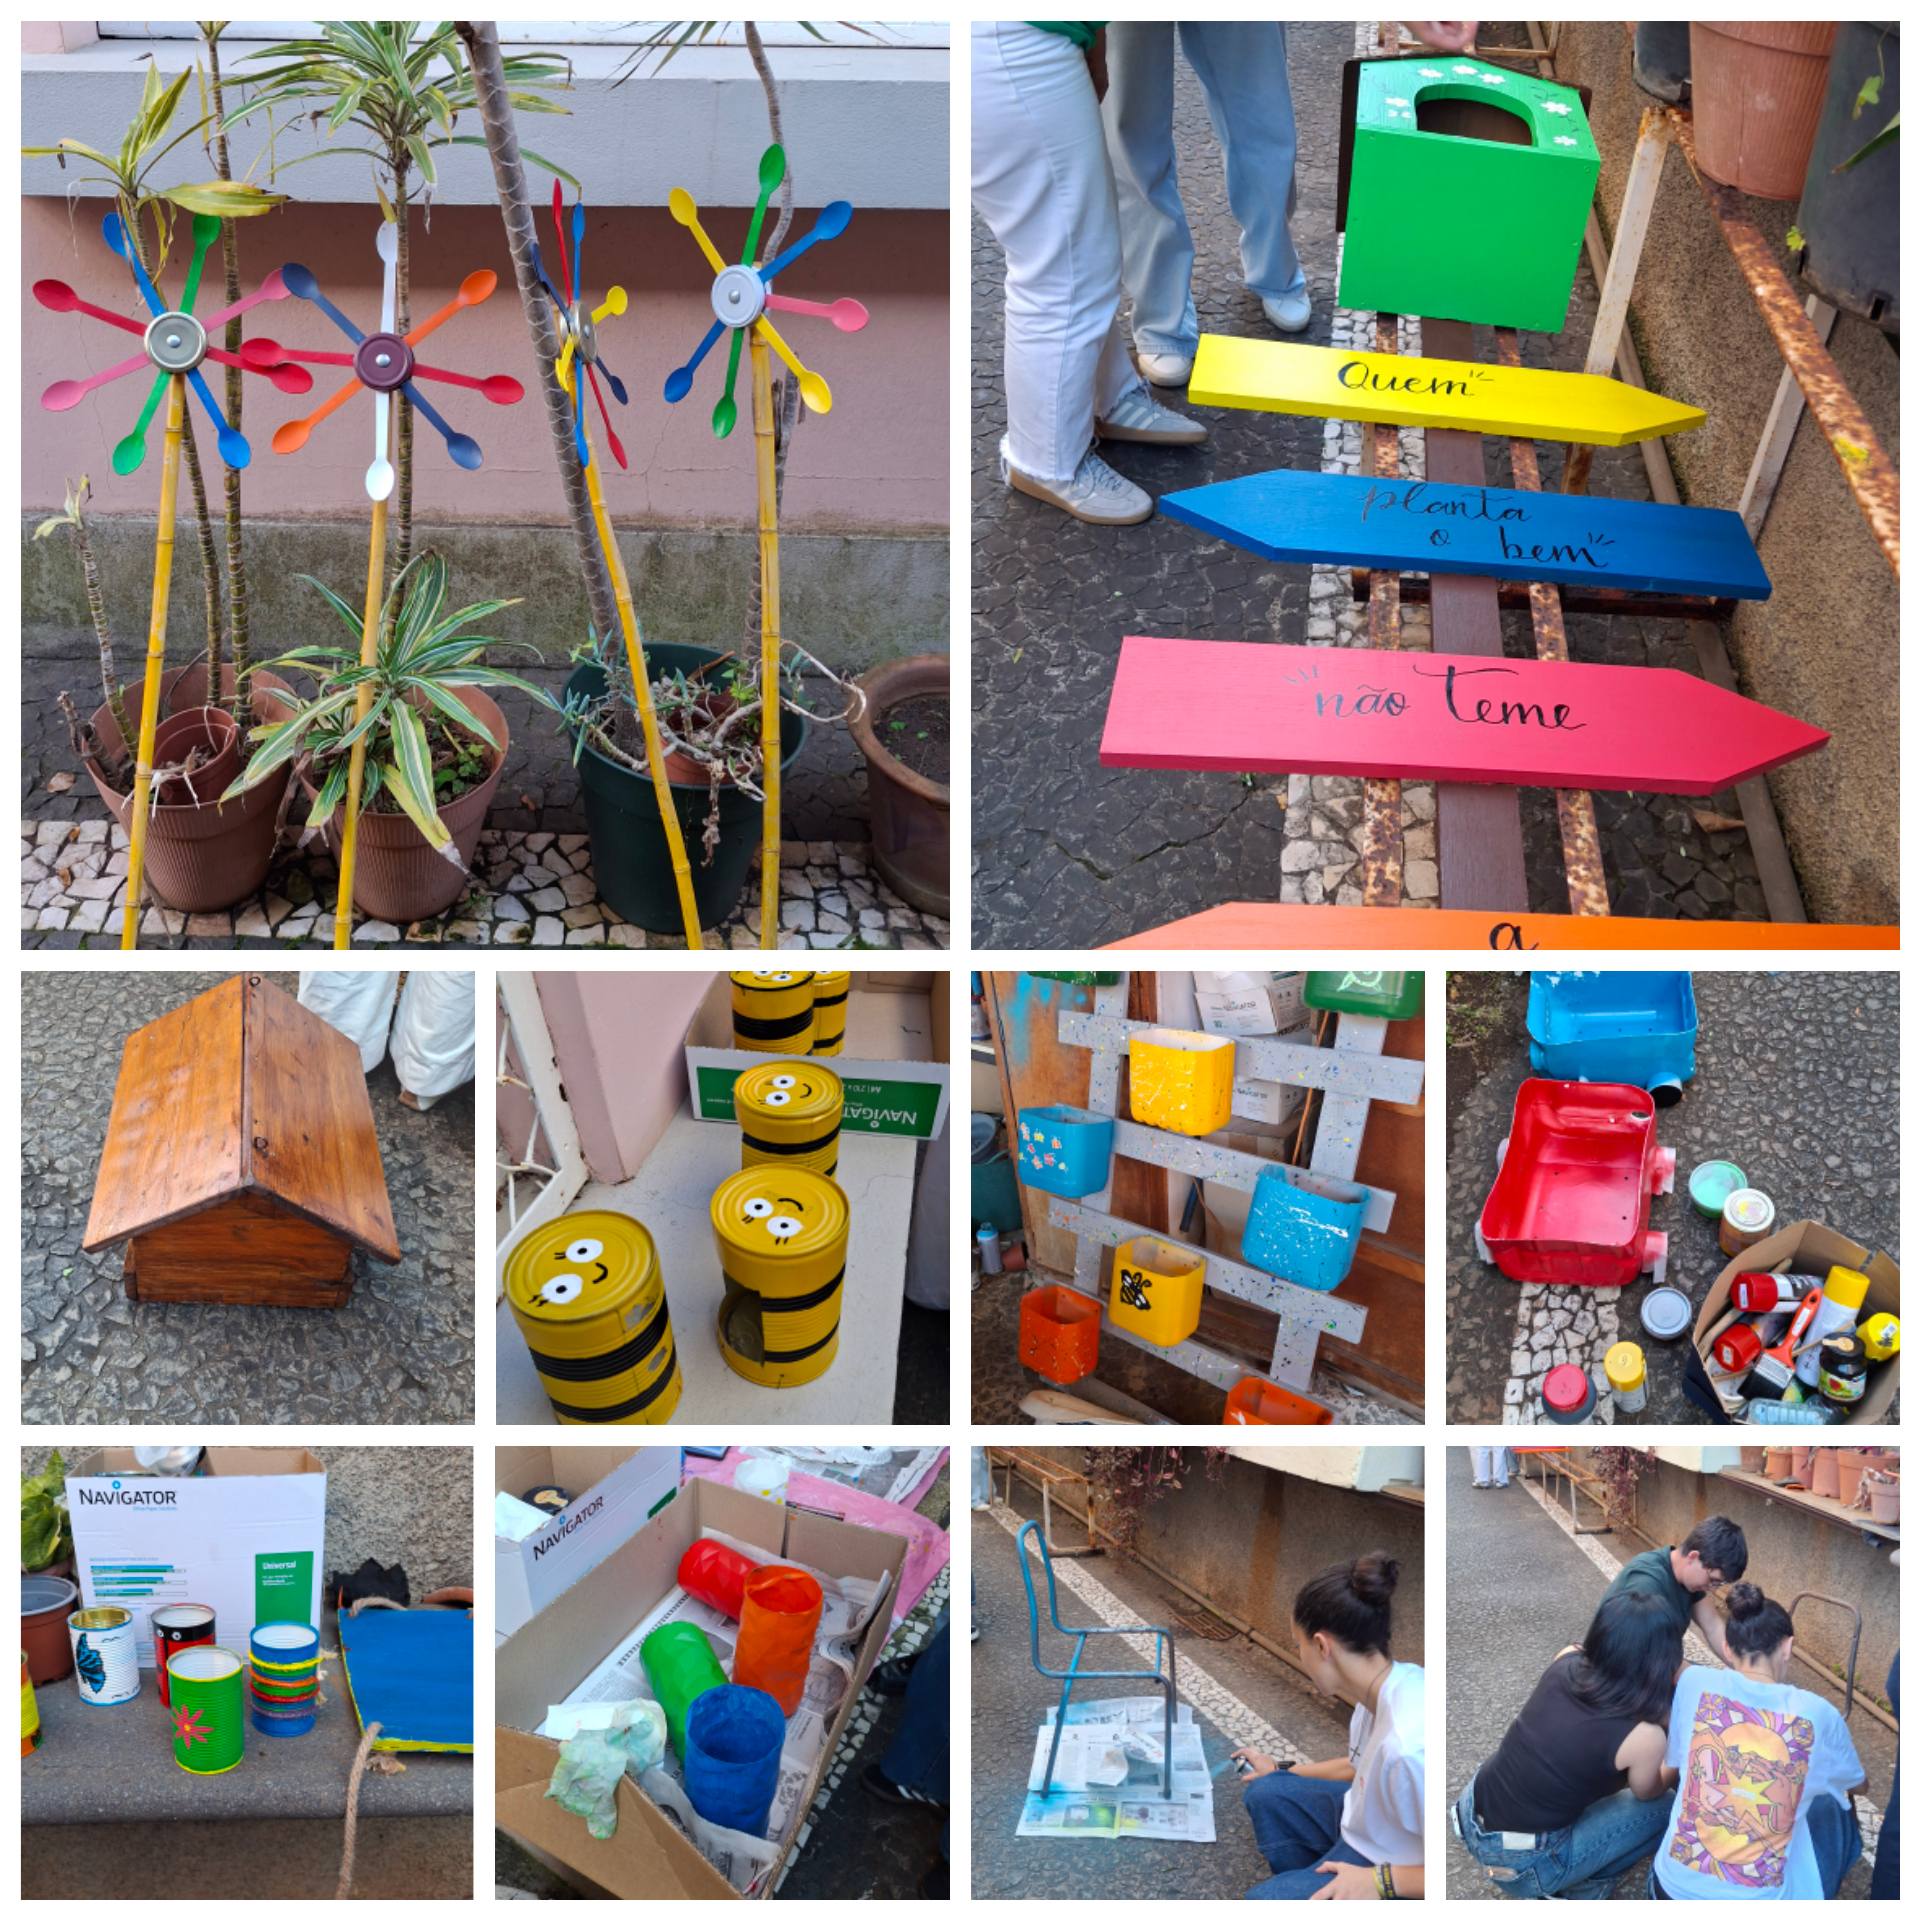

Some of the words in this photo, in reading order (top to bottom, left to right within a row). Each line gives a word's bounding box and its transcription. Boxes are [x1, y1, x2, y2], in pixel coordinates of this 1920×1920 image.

[1338, 362, 1474, 396] Quem
[1361, 483, 1532, 523] planta
[1430, 529, 1451, 546] o
[1500, 526, 1608, 568] bem
[1316, 684, 1410, 718] não
[1489, 922, 1540, 950] a
[843, 1106, 917, 1128] NAVIGAT
[78, 1480, 177, 1505] NAVIGATOR
[533, 1495, 605, 1561] NAVIGATOR
